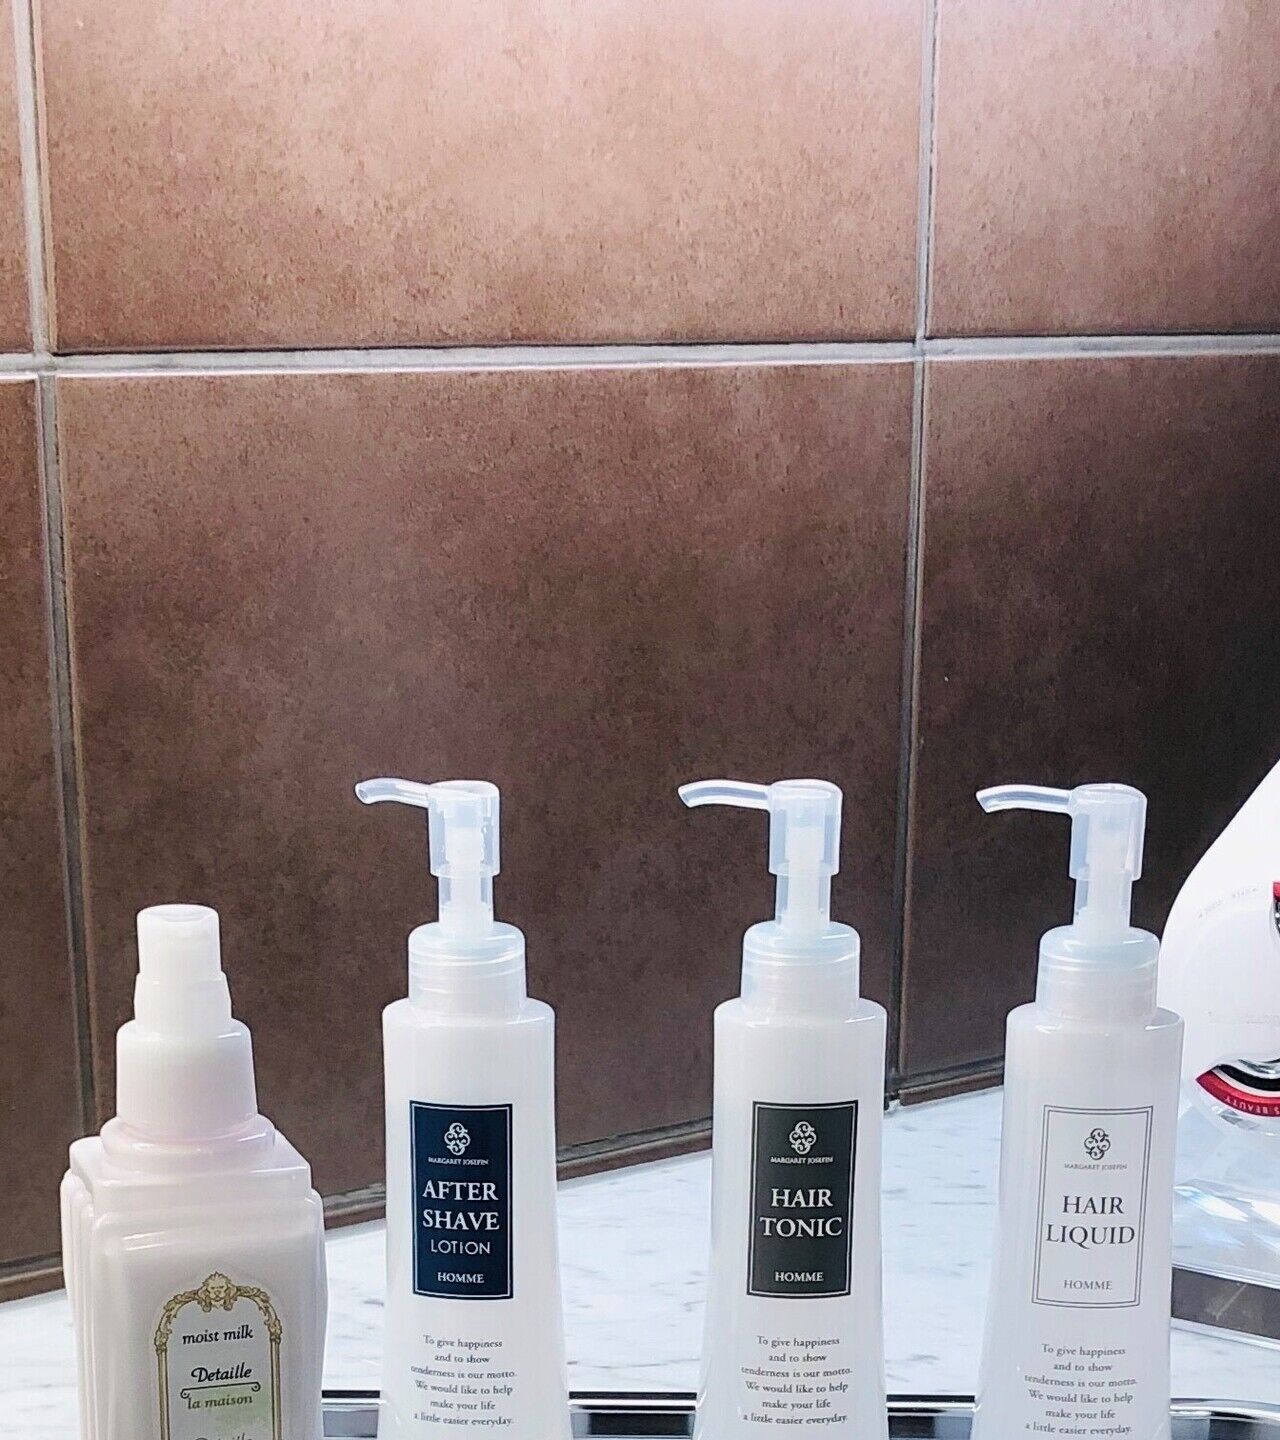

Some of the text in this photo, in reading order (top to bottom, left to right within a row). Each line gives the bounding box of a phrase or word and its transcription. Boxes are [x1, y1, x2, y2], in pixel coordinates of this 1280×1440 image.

[1224, 1096, 1269, 1115] BEAUTY
[1064, 1163, 1100, 1171] MARGARET
[422, 1180, 498, 1200] AFTER
[771, 1188, 834, 1208] HAIR
[1062, 1195, 1124, 1214] HAIR
[422, 1209, 500, 1230] SHAVE
[759, 1216, 843, 1237] TONIC
[1046, 1224, 1136, 1250] LIQUID
[431, 1239, 490, 1255] LOTION
[437, 1272, 484, 1284] HOMME
[775, 1271, 824, 1282] HOMME
[1063, 1280, 1113, 1290] HOMME
[182, 1325, 253, 1345] moist milk
[757, 1335, 840, 1349] To give happiness
[423, 1335, 502, 1350] To give happiness
[768, 1353, 786, 1362] and
[802, 1353, 827, 1362] show
[1041, 1343, 1126, 1358] To give happiness
[434, 1354, 490, 1364] and to show
[191, 1362, 252, 1383] Detaille
[741, 1366, 790, 1378] tenderness
[793, 1369, 800, 1378] is
[1053, 1362, 1112, 1372] and to show
[745, 1381, 848, 1394] We would like to help
[1024, 1374, 1075, 1387] tenderness
[1078, 1379, 1085, 1387] is
[1088, 1380, 1105, 1388] our
[431, 1383, 458, 1394] would
[461, 1385, 477, 1395] like
[481, 1386, 490, 1395] to
[493, 1385, 513, 1396] help
[1028, 1389, 1134, 1404] We would like to help
[187, 1395, 253, 1410] la maison
[430, 1400, 496, 1411] make your life
[762, 1399, 831, 1411] make your life
[442, 1416, 469, 1426] easier
[751, 1412, 773, 1423] little
[775, 1415, 803, 1424] easier
[1045, 1409, 1116, 1421] make your life
[1033, 1421, 1056, 1433] little
[1059, 1425, 1087, 1435] easier
